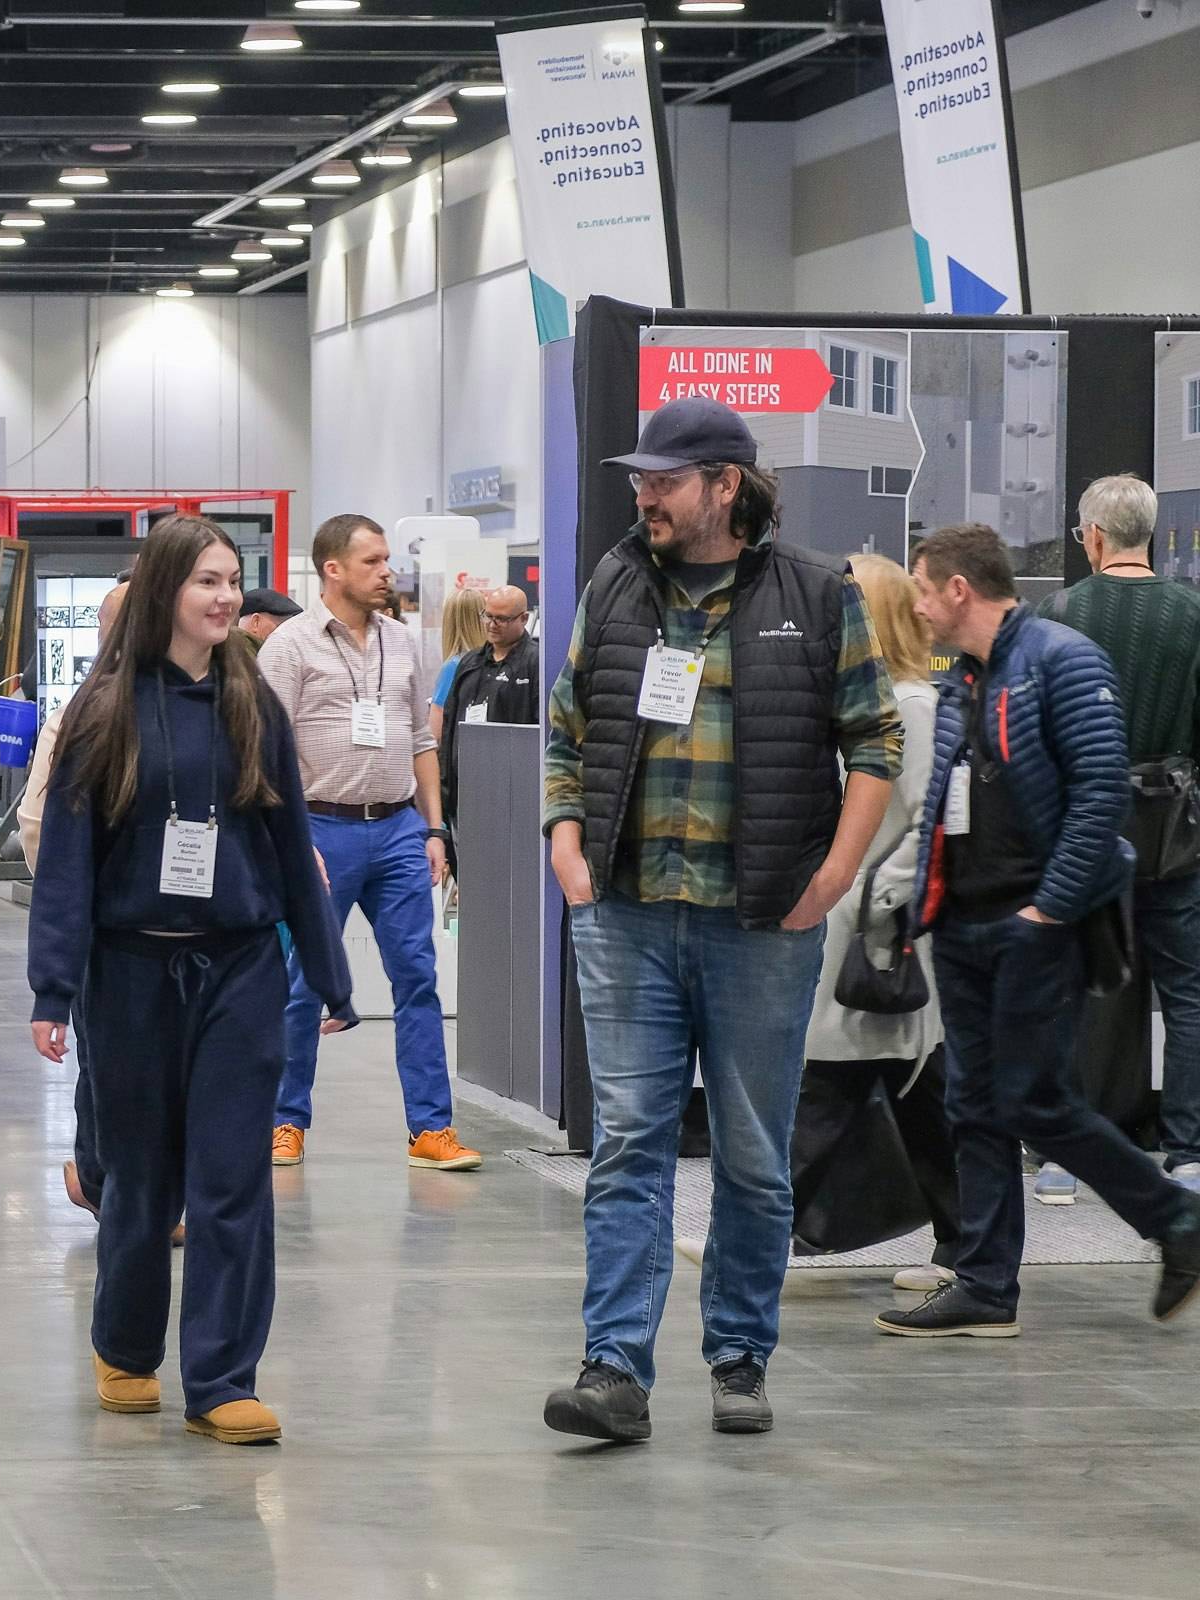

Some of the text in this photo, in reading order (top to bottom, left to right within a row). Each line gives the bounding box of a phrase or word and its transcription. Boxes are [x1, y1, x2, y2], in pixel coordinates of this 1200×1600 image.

[668, 352, 772, 374] ALL DONE IN
[659, 383, 671, 403] 4
[726, 383, 780, 405] STEPS
